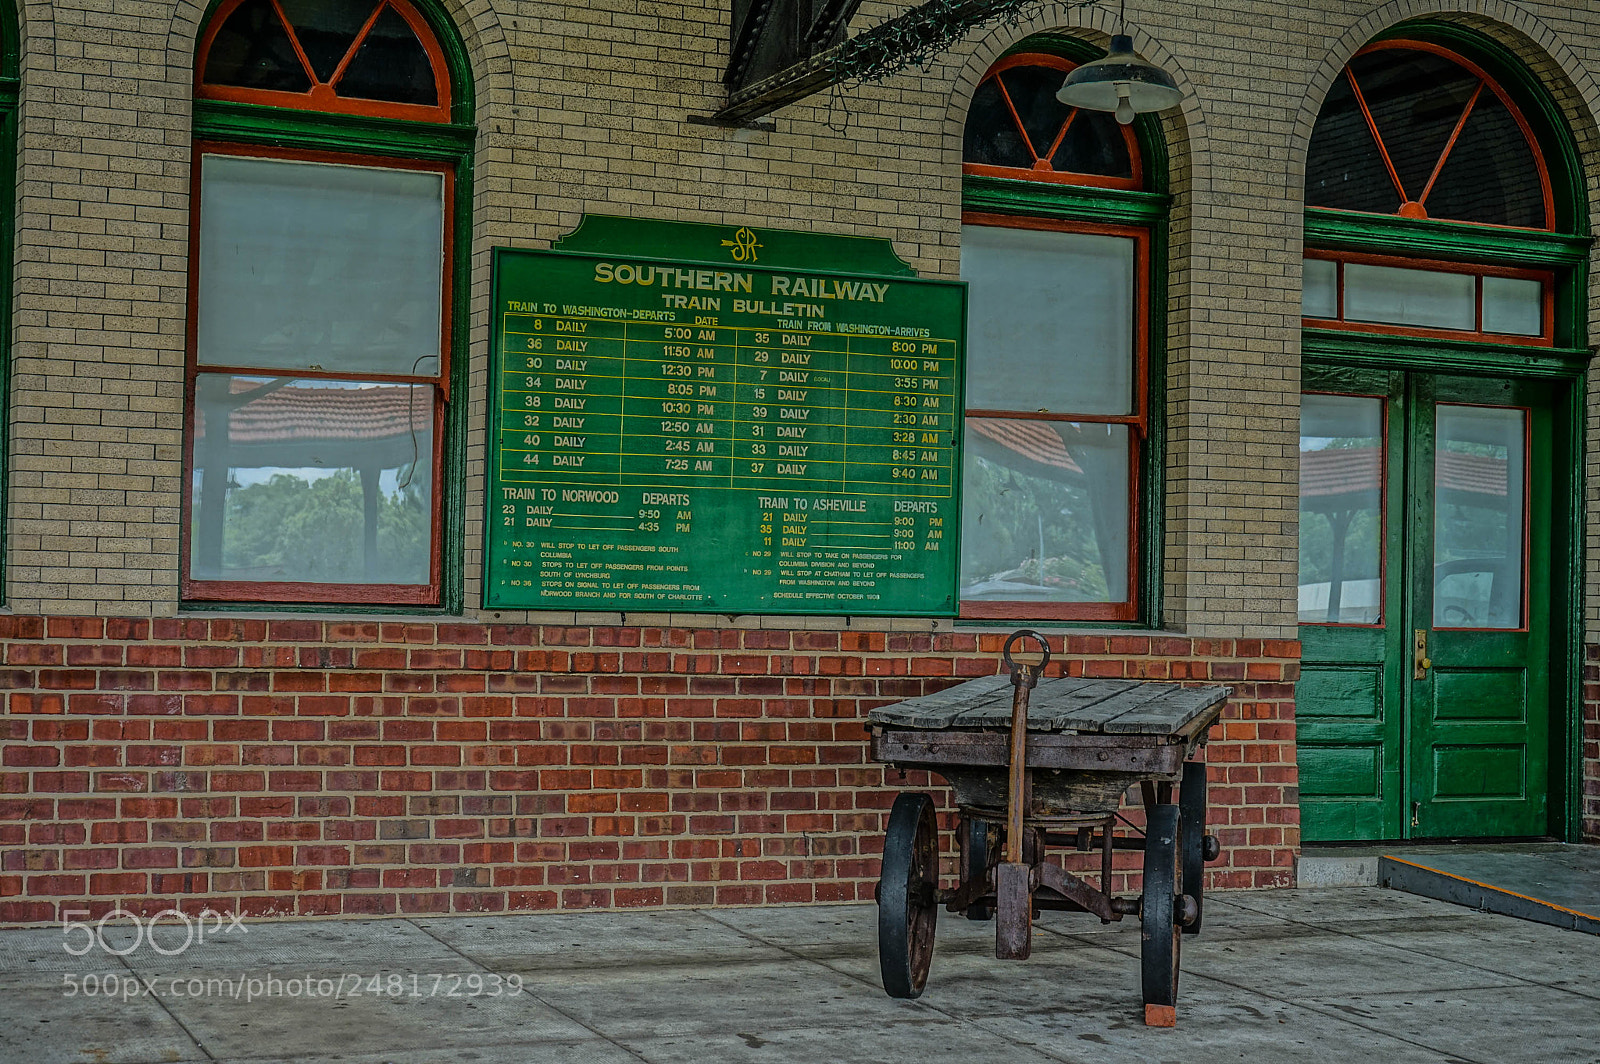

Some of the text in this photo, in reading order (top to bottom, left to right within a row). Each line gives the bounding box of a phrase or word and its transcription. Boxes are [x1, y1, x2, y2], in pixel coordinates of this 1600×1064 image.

[594, 263, 890, 303] SOUTHERN RAILWAY
[508, 301, 676, 321] TRAIN TO WASHINGTON-DEPARTS
[662, 294, 825, 319] TRAIN BULLETIN
[695, 316, 718, 326] DATE
[777, 319, 930, 337] TRAIN FROM WASHINGTON-ARRIVES
[534, 320, 715, 341] 8 DAILY 5:00 AM
[527, 338, 714, 359] 36 DAILY 11:50 AM
[755, 333, 937, 354] 35 DAILY 8:00 PM
[526, 358, 715, 377] 30 DAILY 12:30 PM
[755, 352, 939, 372] 29 DAILY 10:00 PM
[525, 377, 716, 396] 34 DAILY 8:05 PM
[760, 370, 767, 380] 7
[780, 371, 809, 383] DAILY
[894, 378, 918, 388] 3:55
[922, 379, 939, 390] PM
[525, 396, 714, 415] 38 DAILY 10:30 PM
[754, 389, 939, 408] 15 DAILY 8:30 AM
[524, 415, 714, 434] 32 DAILY 12:50 AM
[753, 407, 938, 426] 39 DAILY 2:30 AM
[752, 426, 938, 443] 31 DAILY 3:28 AM
[524, 435, 714, 453] 40 DAILY 2:45 AM
[752, 444, 938, 462] 33 DAILY 8:45 AM
[523, 454, 713, 471] 44 DAILY 7:25 AM
[751, 463, 938, 480] 37 DAILY 9:40 AM
[502, 488, 690, 506] TRAIN TO NORWOOD DEPARTS
[758, 497, 937, 513] TRAIN TO ASHEVILLE DEPARTS
[502, 505, 692, 520] 23 DAILY 9:50 AM
[762, 513, 943, 527] 21 DAILY 9:00 PM
[504, 518, 691, 532] 21 DAILY 4:35 PM
[760, 525, 942, 539] 35 DAILY 9:00 AM
[764, 537, 939, 551] 11 DAILY 11:00 AM
